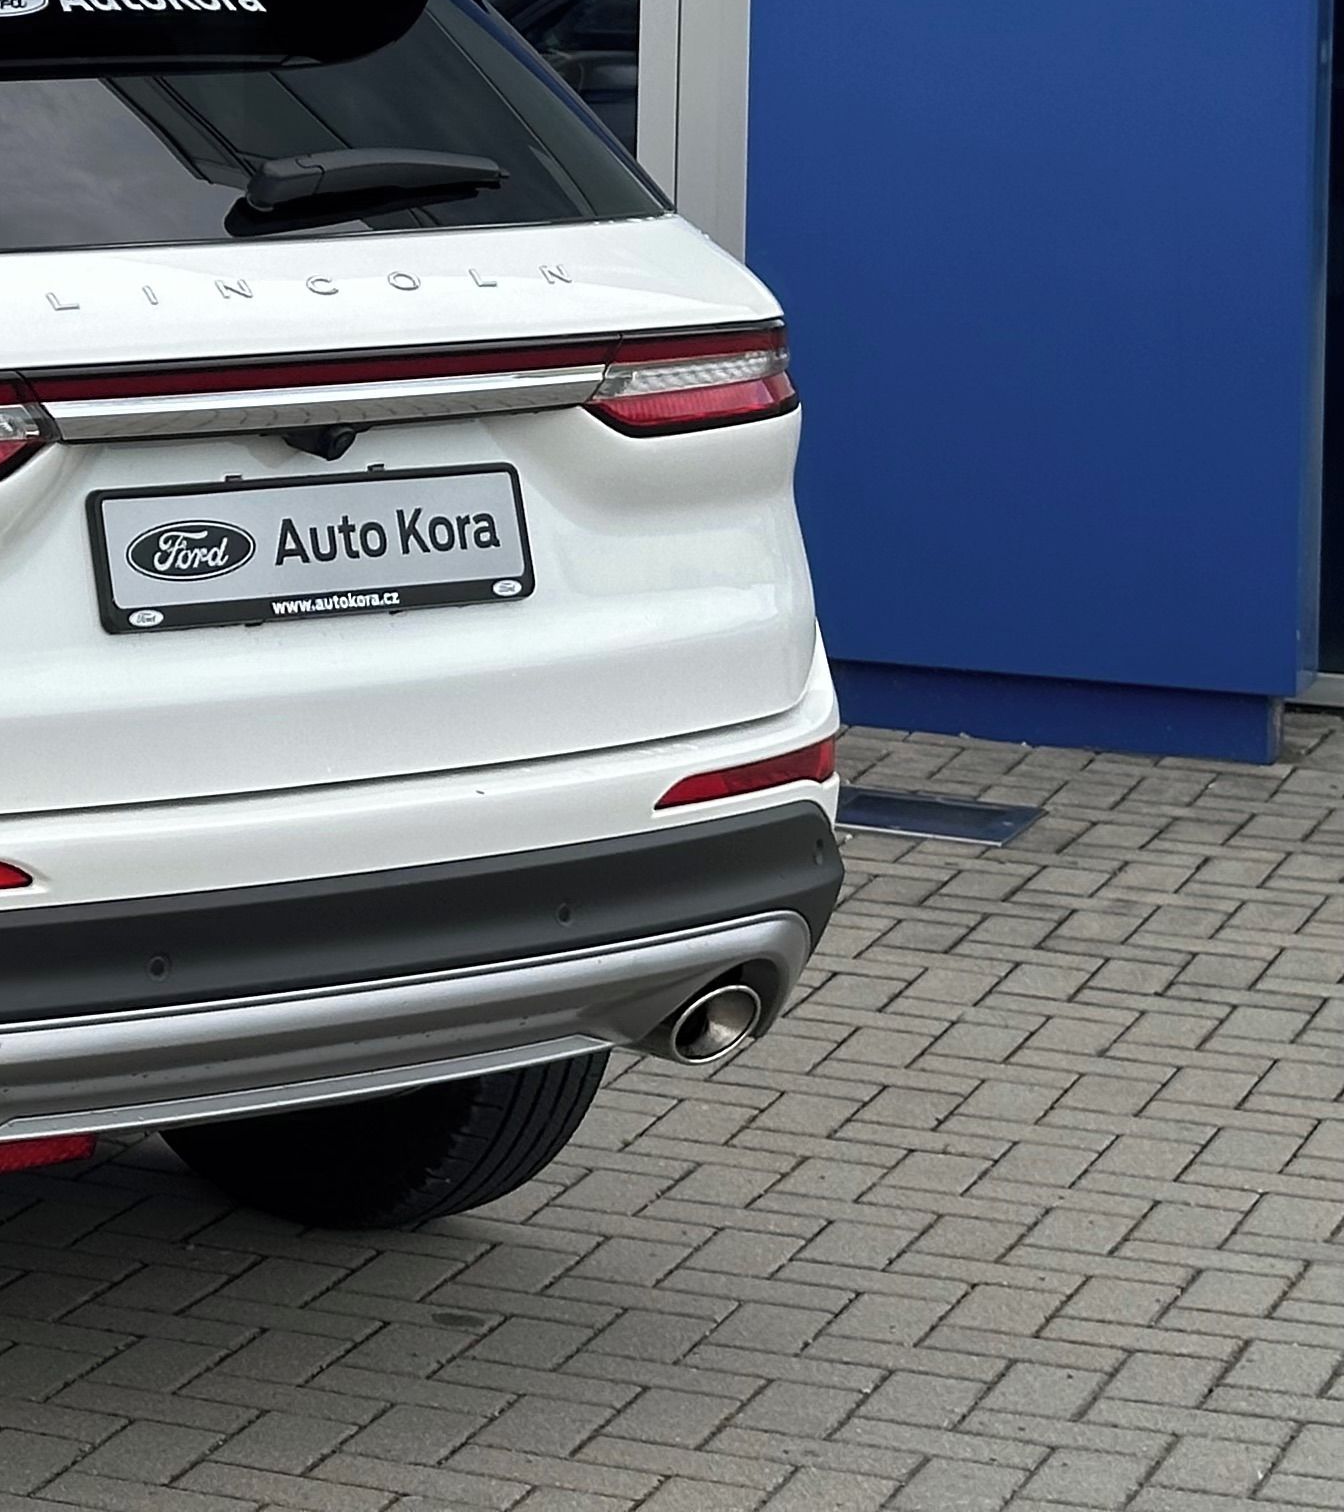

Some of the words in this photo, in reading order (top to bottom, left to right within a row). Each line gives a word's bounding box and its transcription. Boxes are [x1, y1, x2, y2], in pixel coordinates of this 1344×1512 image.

[45, 264, 573, 312] LINCOLN
[153, 529, 229, 571] Ford
[274, 515, 388, 566] Auto
[395, 507, 501, 556] Kora
[272, 590, 401, 615] www.autokora.cz
